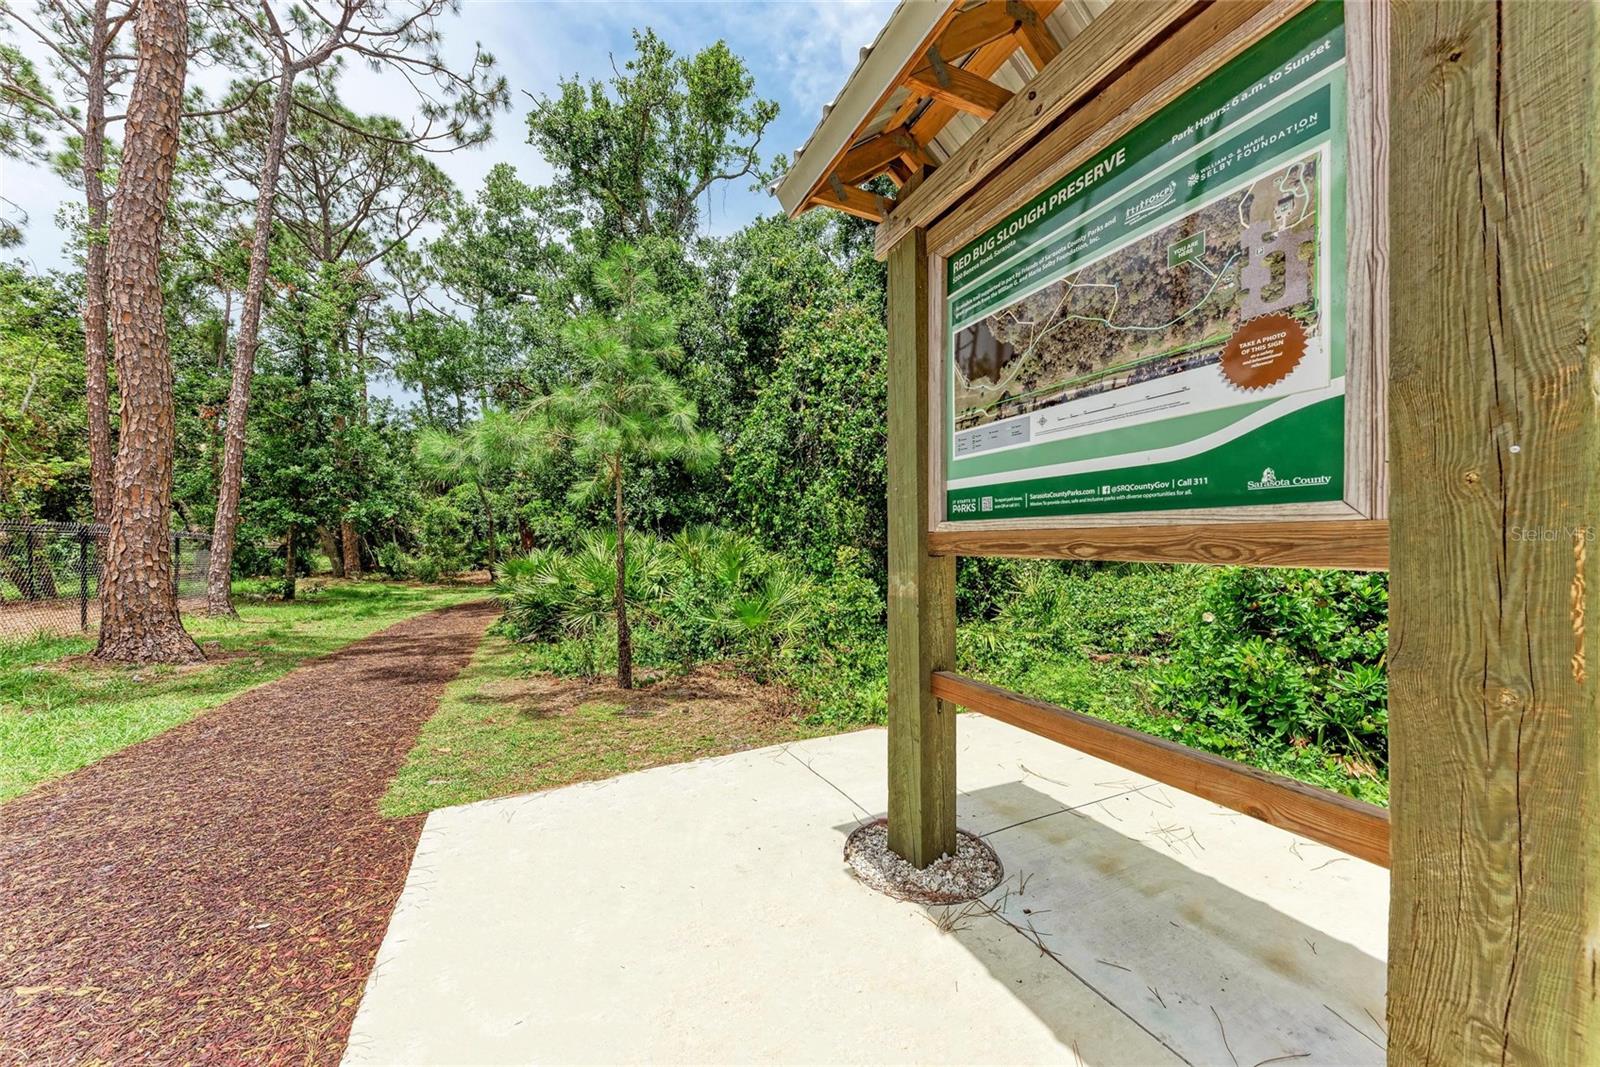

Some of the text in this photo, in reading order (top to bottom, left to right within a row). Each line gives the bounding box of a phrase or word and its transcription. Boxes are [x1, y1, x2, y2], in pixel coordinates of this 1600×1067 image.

[1171, 39, 1331, 145] Park Hours: 6 a.m. to Sunset
[1200, 112, 1318, 181] SELBY FOUNDATION
[1200, 155, 1227, 174] WILLIAM
[1243, 134, 1265, 150] MARIE
[953, 253, 972, 274] RED
[972, 236, 995, 261] BUG
[996, 201, 1047, 245] SLOUGH
[1049, 147, 1126, 211] PRESERVE
[1067, 232, 1087, 250] County
[1087, 223, 1104, 238] Parks
[1104, 216, 1117, 228] and
[1174, 240, 1199, 255] YOU ARE
[1239, 340, 1256, 349] TAKE
[1262, 331, 1287, 343] PHOTO
[1251, 344, 1266, 352] THIS
[1267, 338, 1284, 348] SIGN
[1111, 477, 1208, 494] @SRQCountyGov Call 311
[1247, 475, 1332, 489] Sarasota County
[1029, 489, 1096, 500] SarasotaCountyParks.com
[952, 503, 976, 514] PARKS
